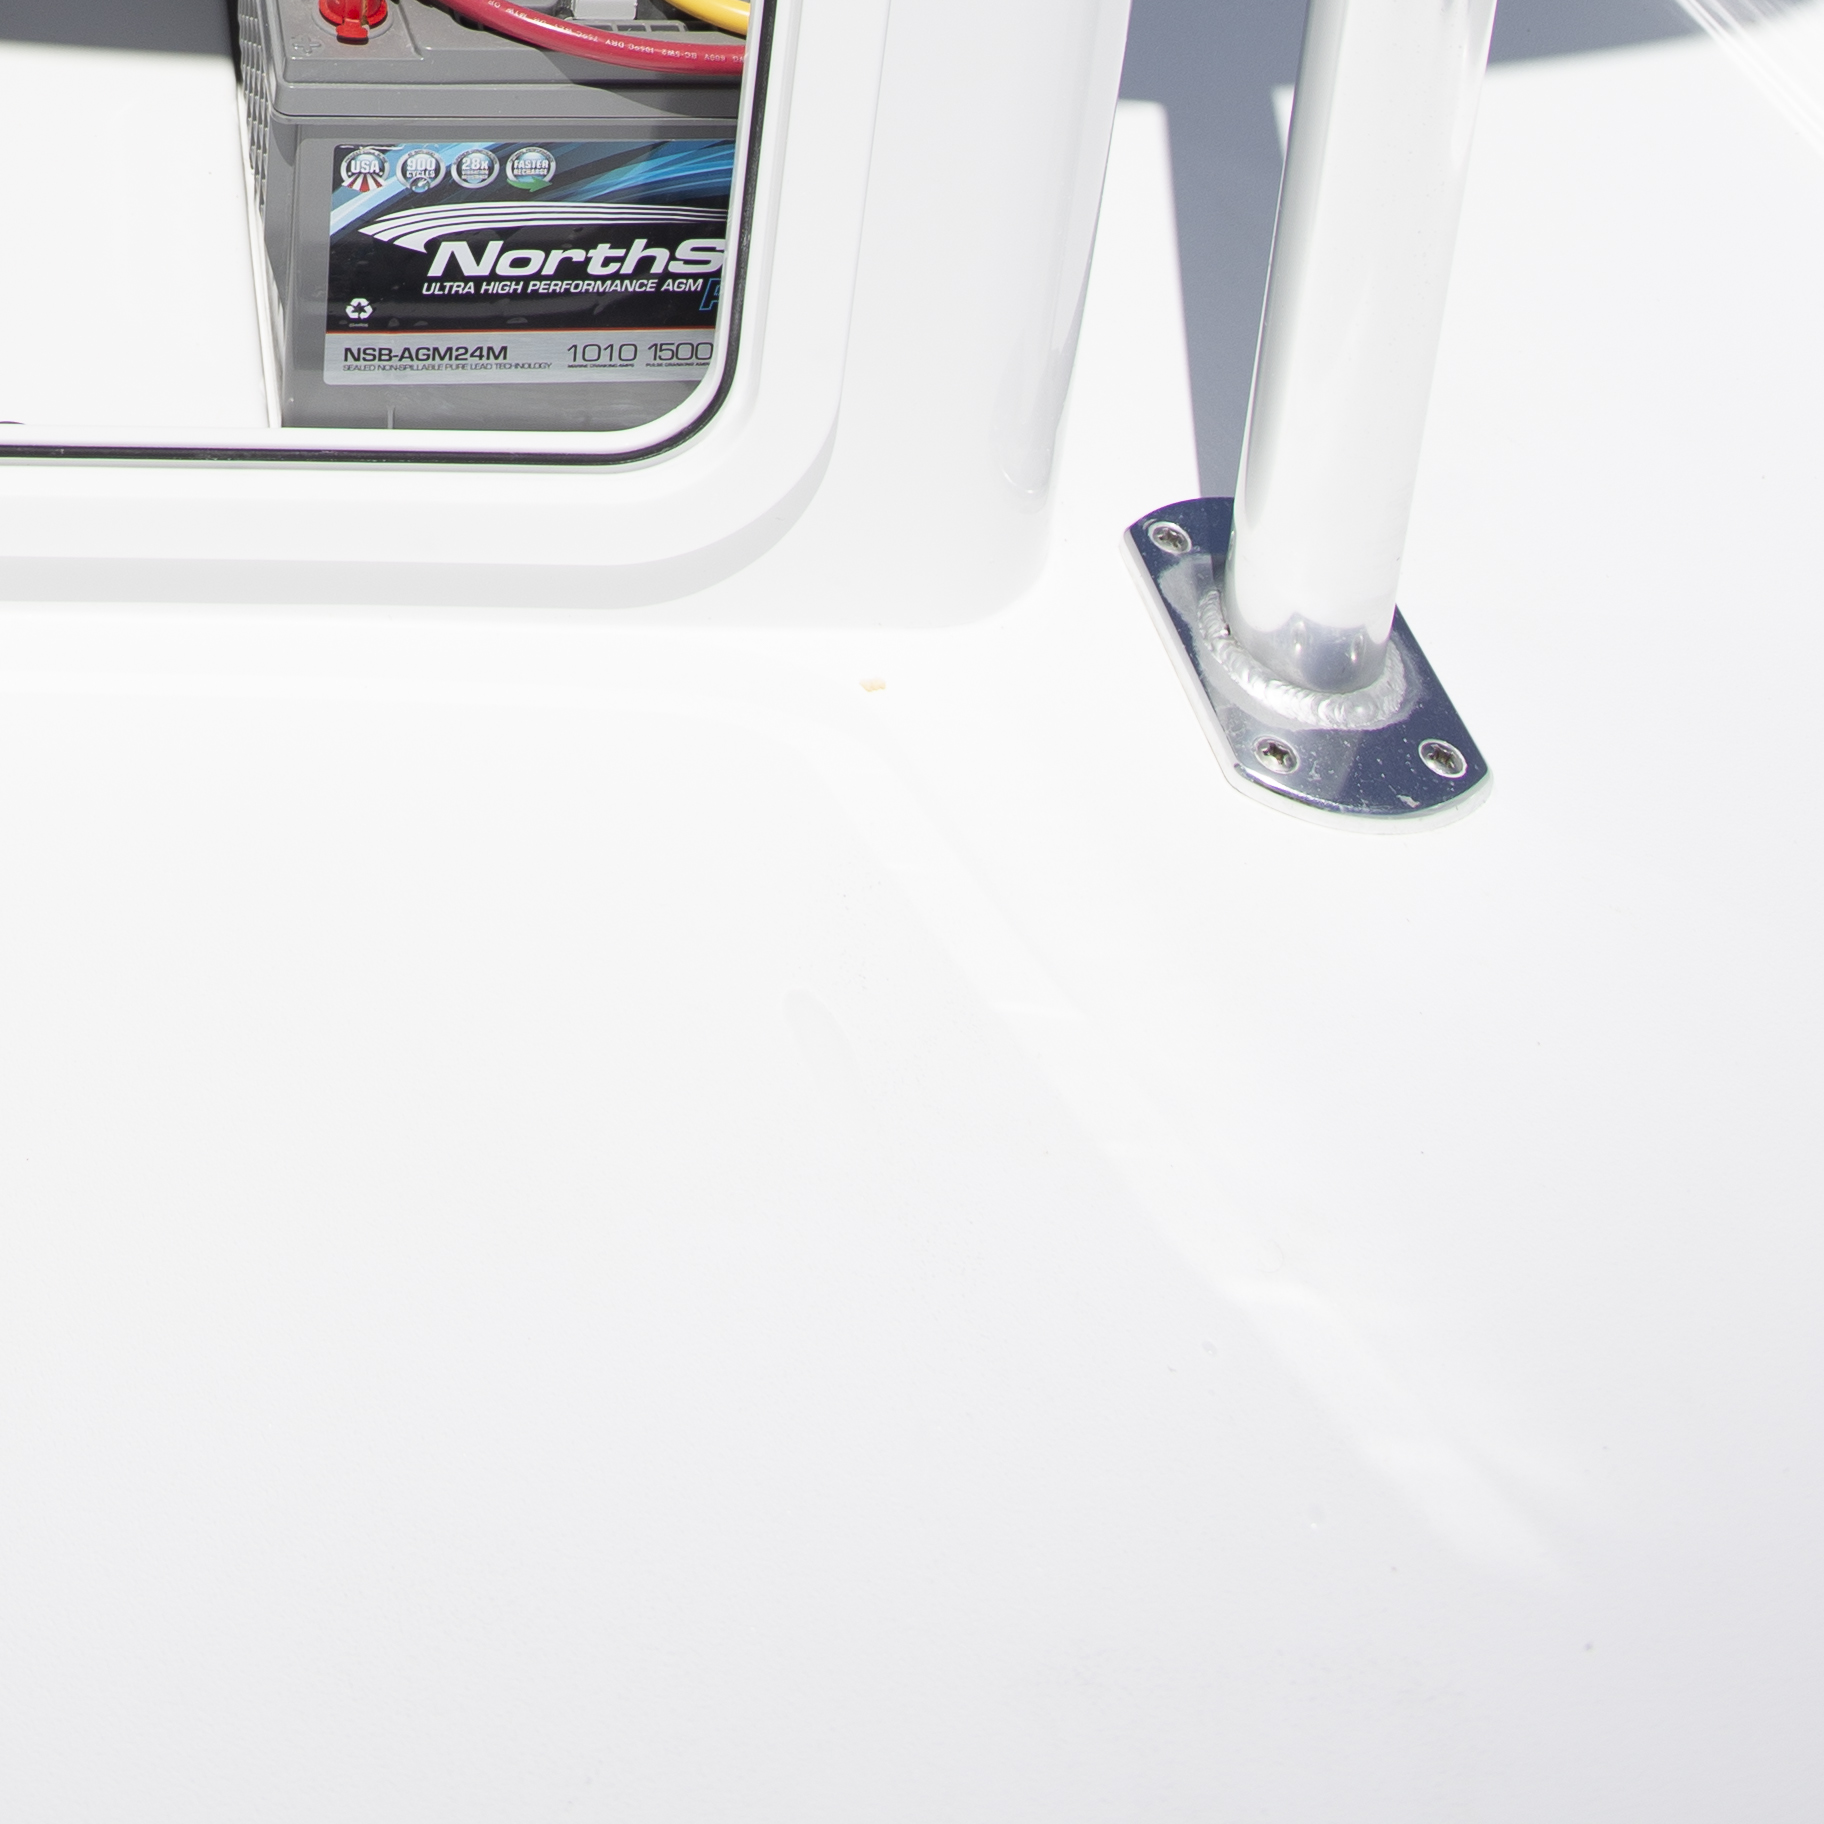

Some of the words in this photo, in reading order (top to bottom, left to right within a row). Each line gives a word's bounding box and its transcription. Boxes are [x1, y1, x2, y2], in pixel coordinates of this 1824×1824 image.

[604, 37, 624, 49] DRY
[350, 160, 380, 173] USA
[406, 158, 436, 170] 900
[513, 159, 549, 169] FASTER
[406, 170, 436, 178] CYCLES
[513, 168, 548, 176] RECHARGE
[421, 280, 476, 295] ULTRA
[480, 280, 521, 294] HIGH
[527, 278, 656, 294] PERFORMANCE
[660, 278, 703, 292] AGM
[343, 345, 508, 362] NSB-AGM24M
[567, 343, 638, 363] 1010
[647, 341, 714, 362] 1500
[343, 363, 376, 372] SEALED
[377, 363, 443, 371] NON-SPILLABLE
[494, 362, 553, 370] TECHNOLOGY
